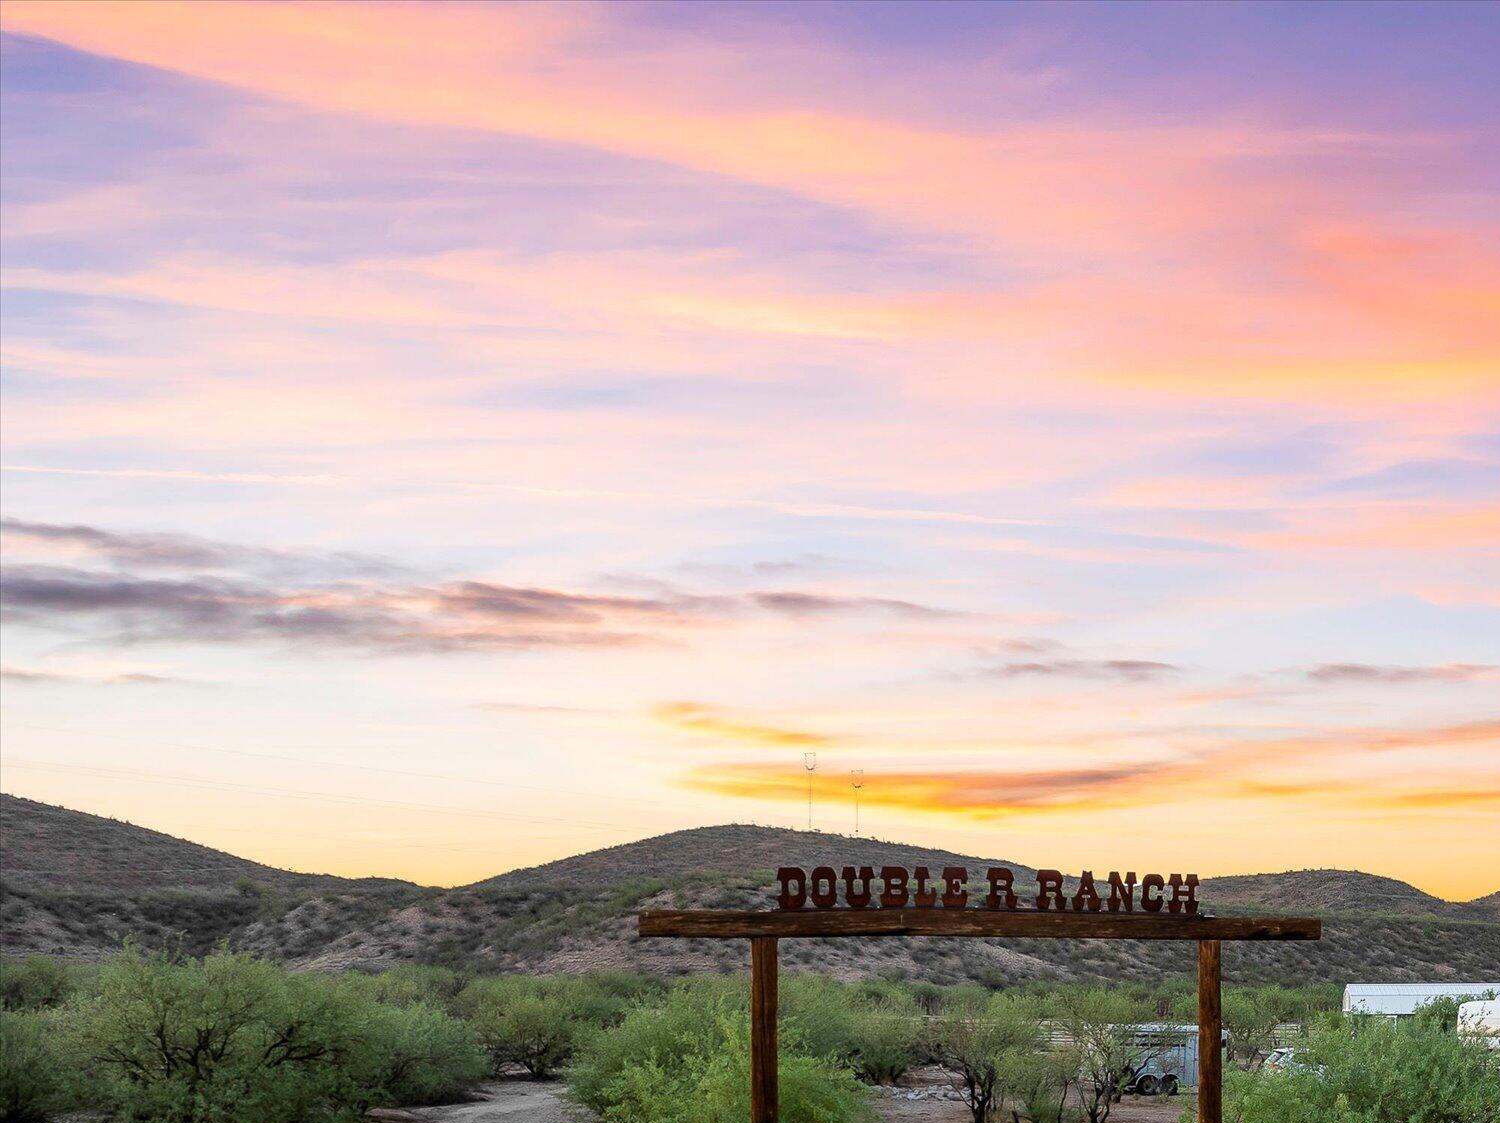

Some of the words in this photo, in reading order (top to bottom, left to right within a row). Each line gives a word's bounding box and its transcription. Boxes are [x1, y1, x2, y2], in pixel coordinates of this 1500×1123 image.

[776, 866, 968, 910] DOUBLE
[986, 867, 1019, 911] R
[1035, 869, 1200, 914] RANCH
